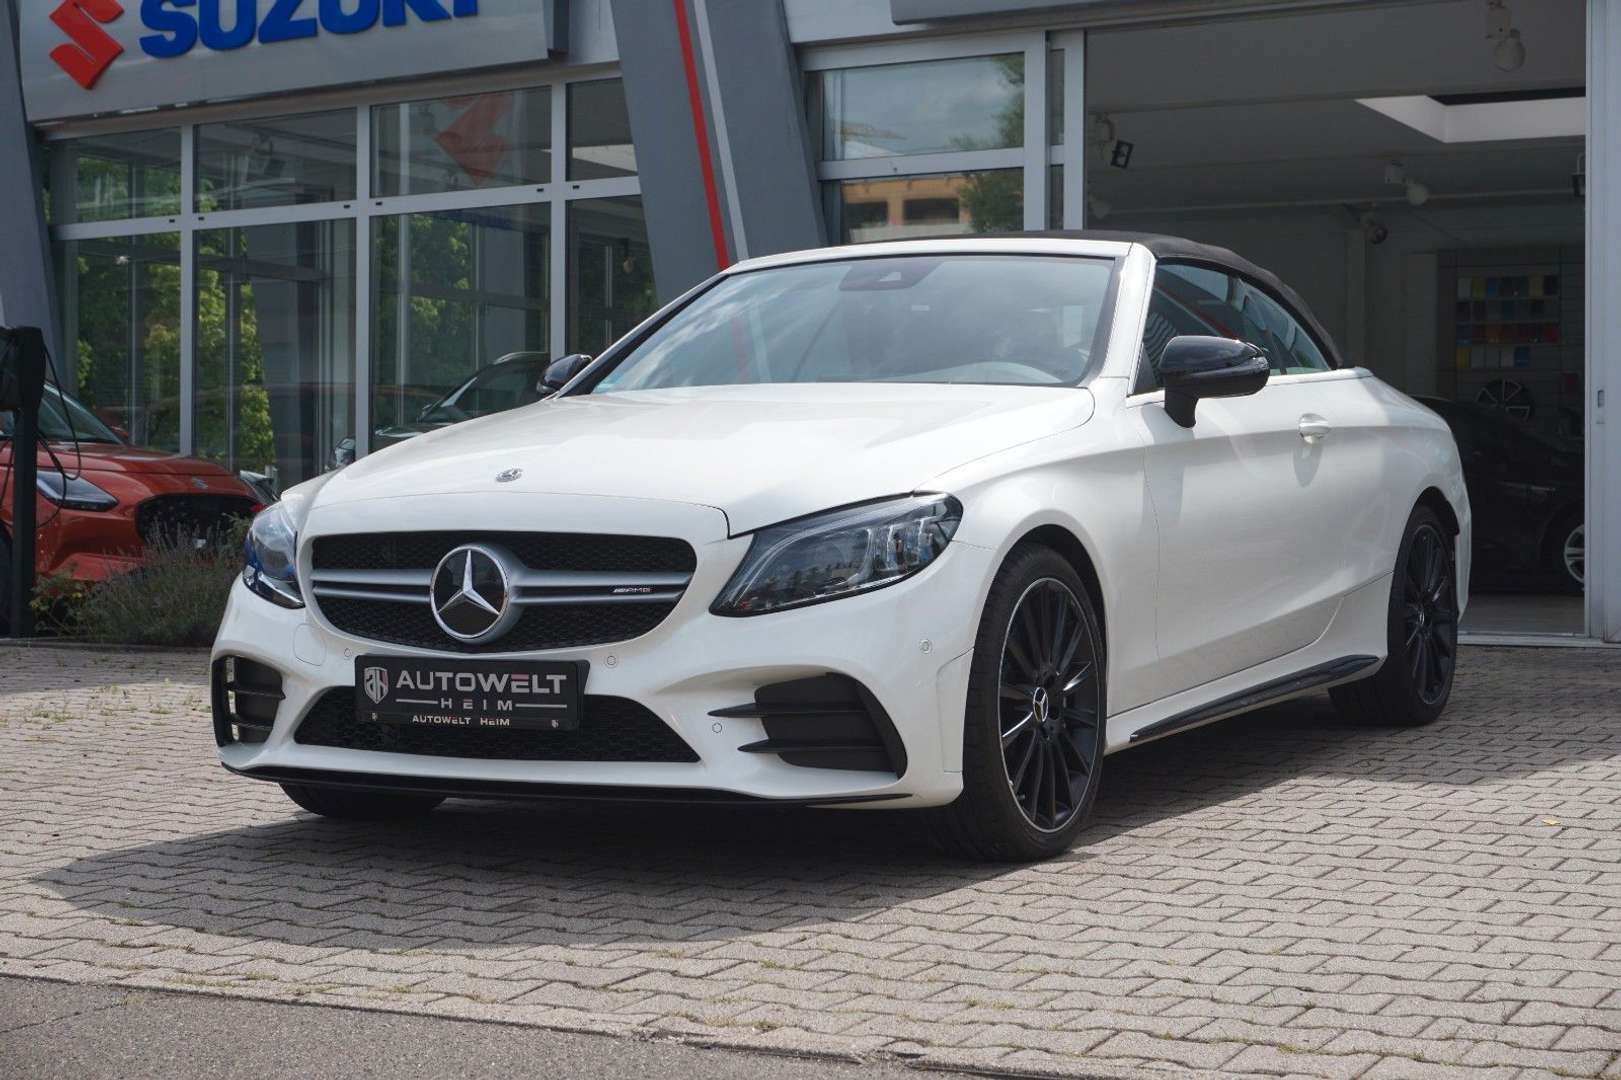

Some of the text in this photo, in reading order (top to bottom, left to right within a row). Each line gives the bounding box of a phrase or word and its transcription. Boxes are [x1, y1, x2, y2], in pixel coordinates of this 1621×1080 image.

[139, 0, 479, 59] SUZU
[395, 669, 567, 695] AUTOWELT
[440, 697, 513, 712] HEIM
[412, 713, 511, 727] AUTOWELT HEIM
